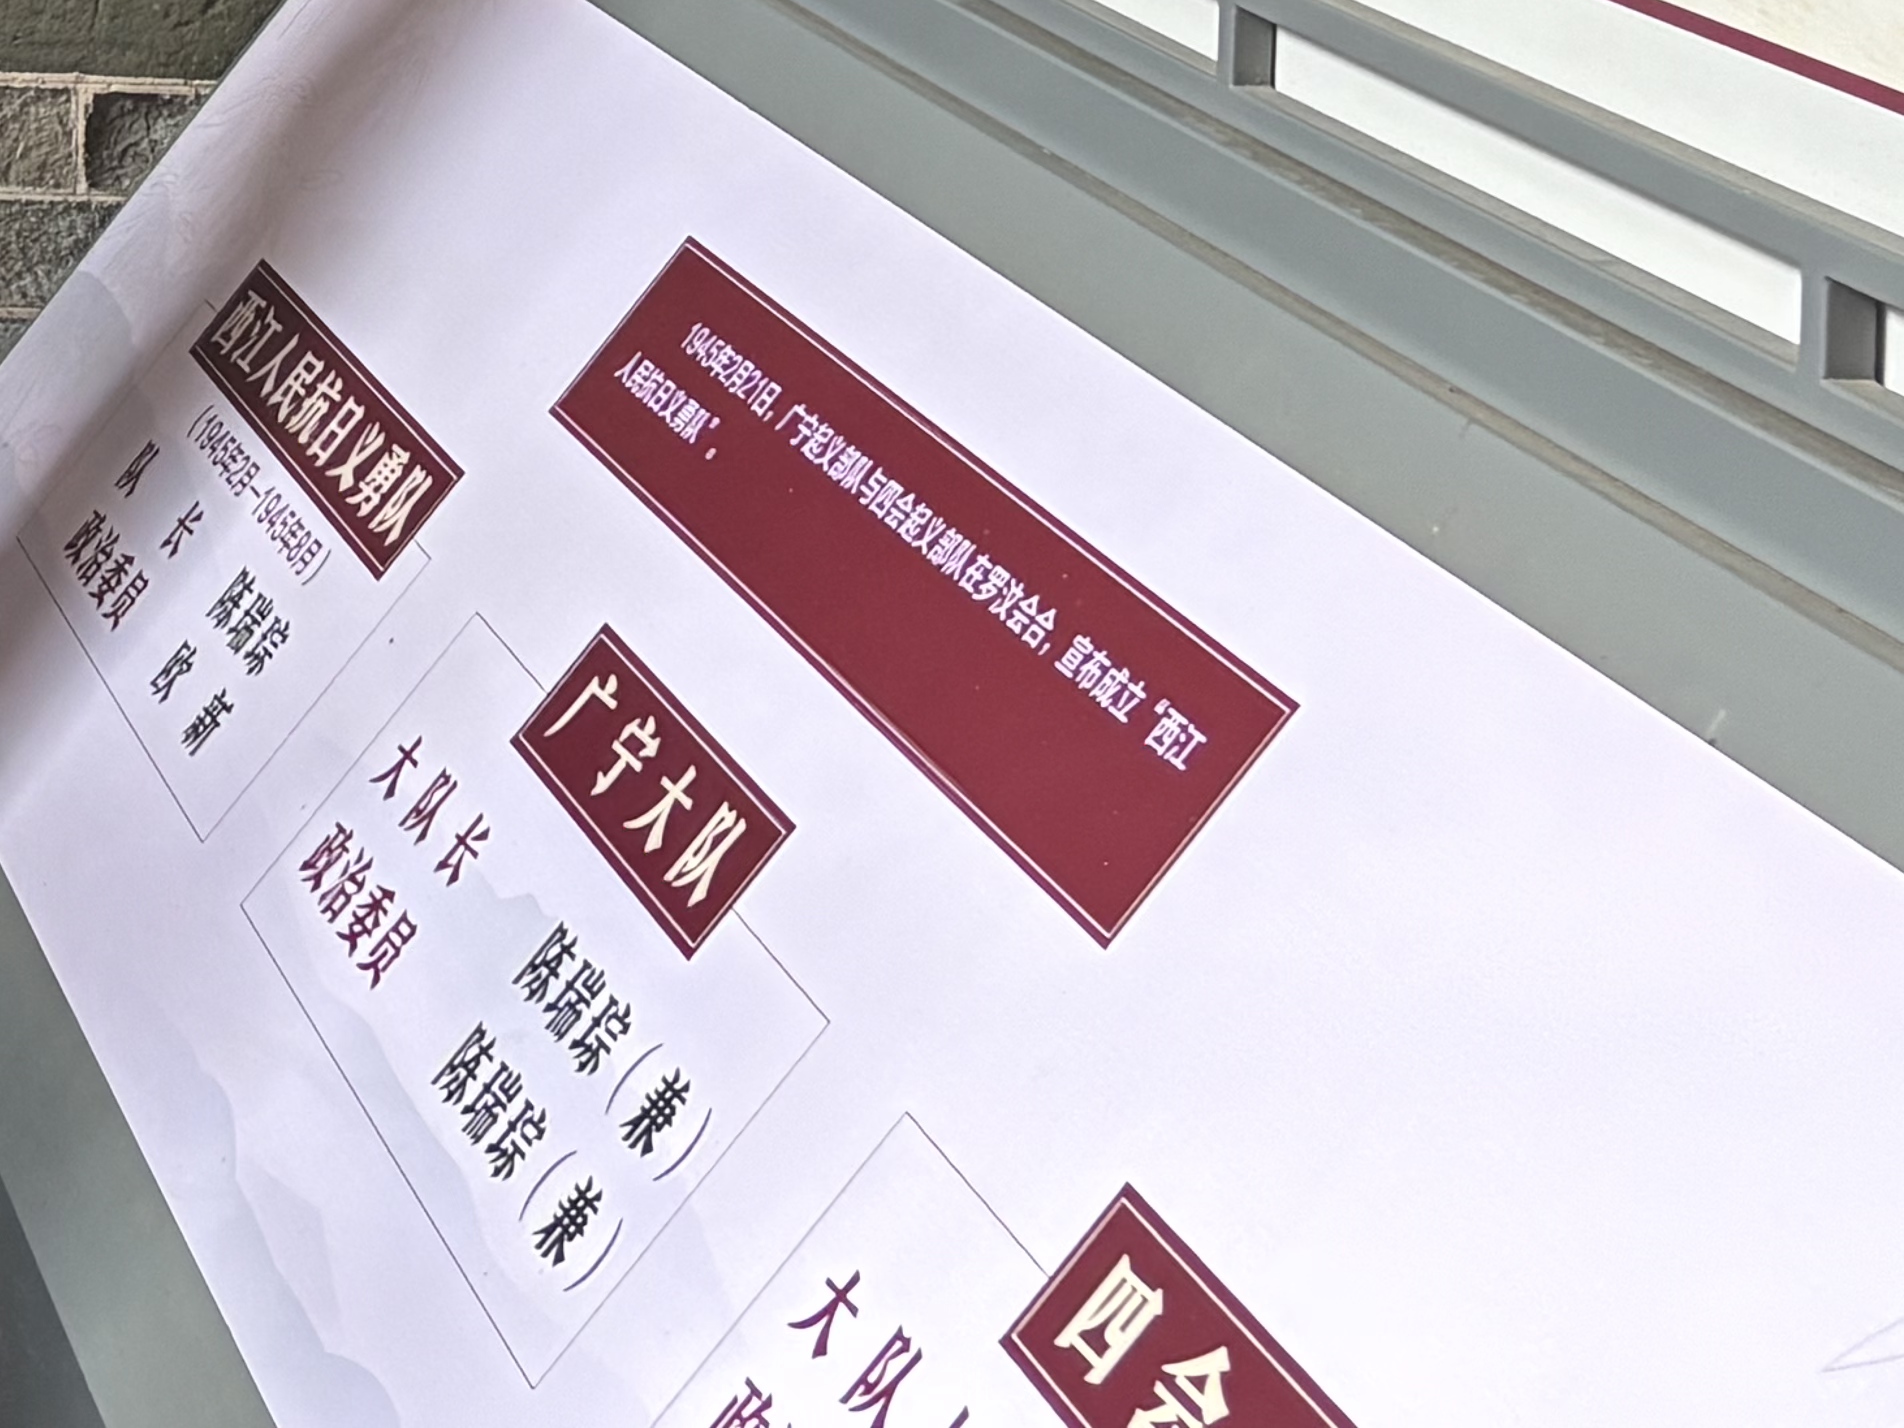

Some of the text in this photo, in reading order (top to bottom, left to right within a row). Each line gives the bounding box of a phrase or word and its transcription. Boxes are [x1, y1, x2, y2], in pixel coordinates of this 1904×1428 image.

[210, 290, 435, 548] 西江人民抗日义勇队
[63, 510, 151, 631] 政治委员
[206, 568, 291, 676] 陈瑞琮
[370, 737, 494, 888] 大队长
[545, 675, 747, 907] 广宁大队
[299, 823, 417, 989] 政治委员
[788, 1270, 971, 1428] 大队
